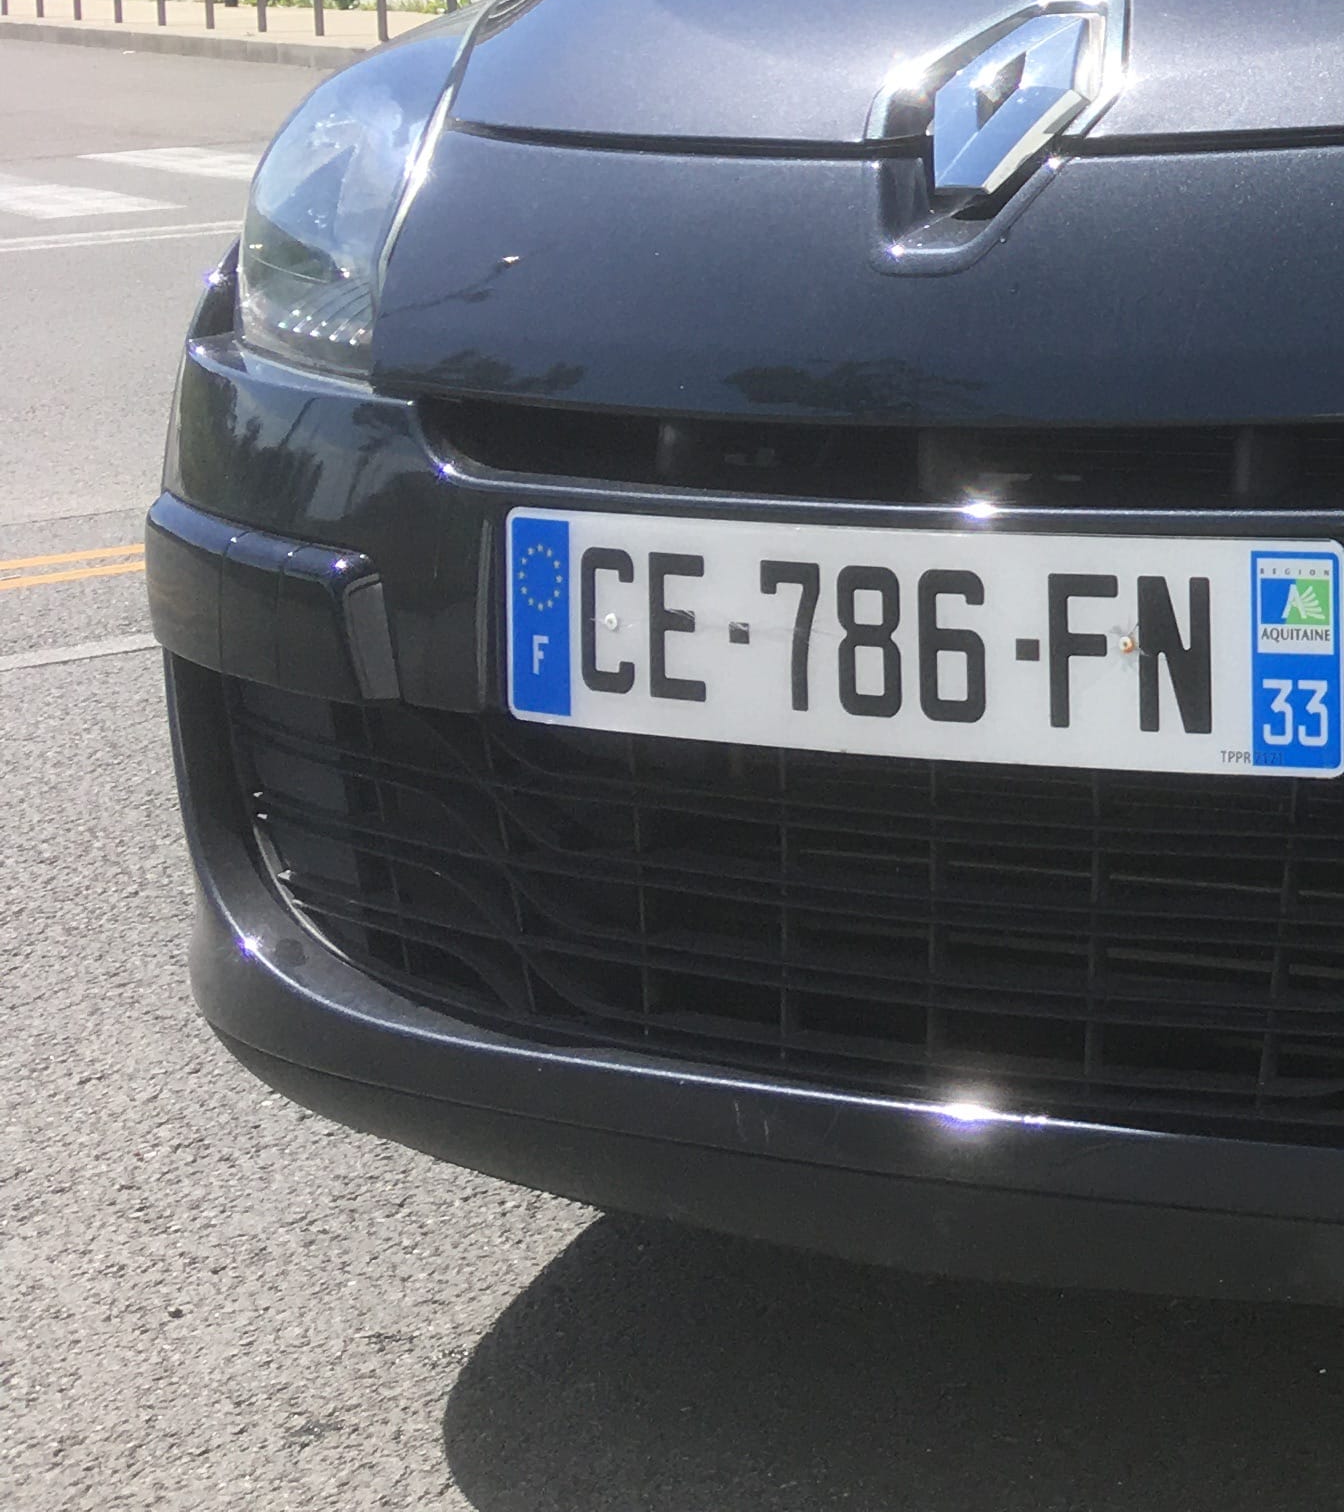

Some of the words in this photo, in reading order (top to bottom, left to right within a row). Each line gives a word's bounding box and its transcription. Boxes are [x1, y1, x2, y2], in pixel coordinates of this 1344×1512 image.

[580, 546, 1213, 735] CE-786-FN
[1261, 627, 1331, 642] AQUITAINE
[532, 635, 549, 674] F
[1262, 679, 1329, 747] 33
[1220, 750, 1251, 764] TPPR
